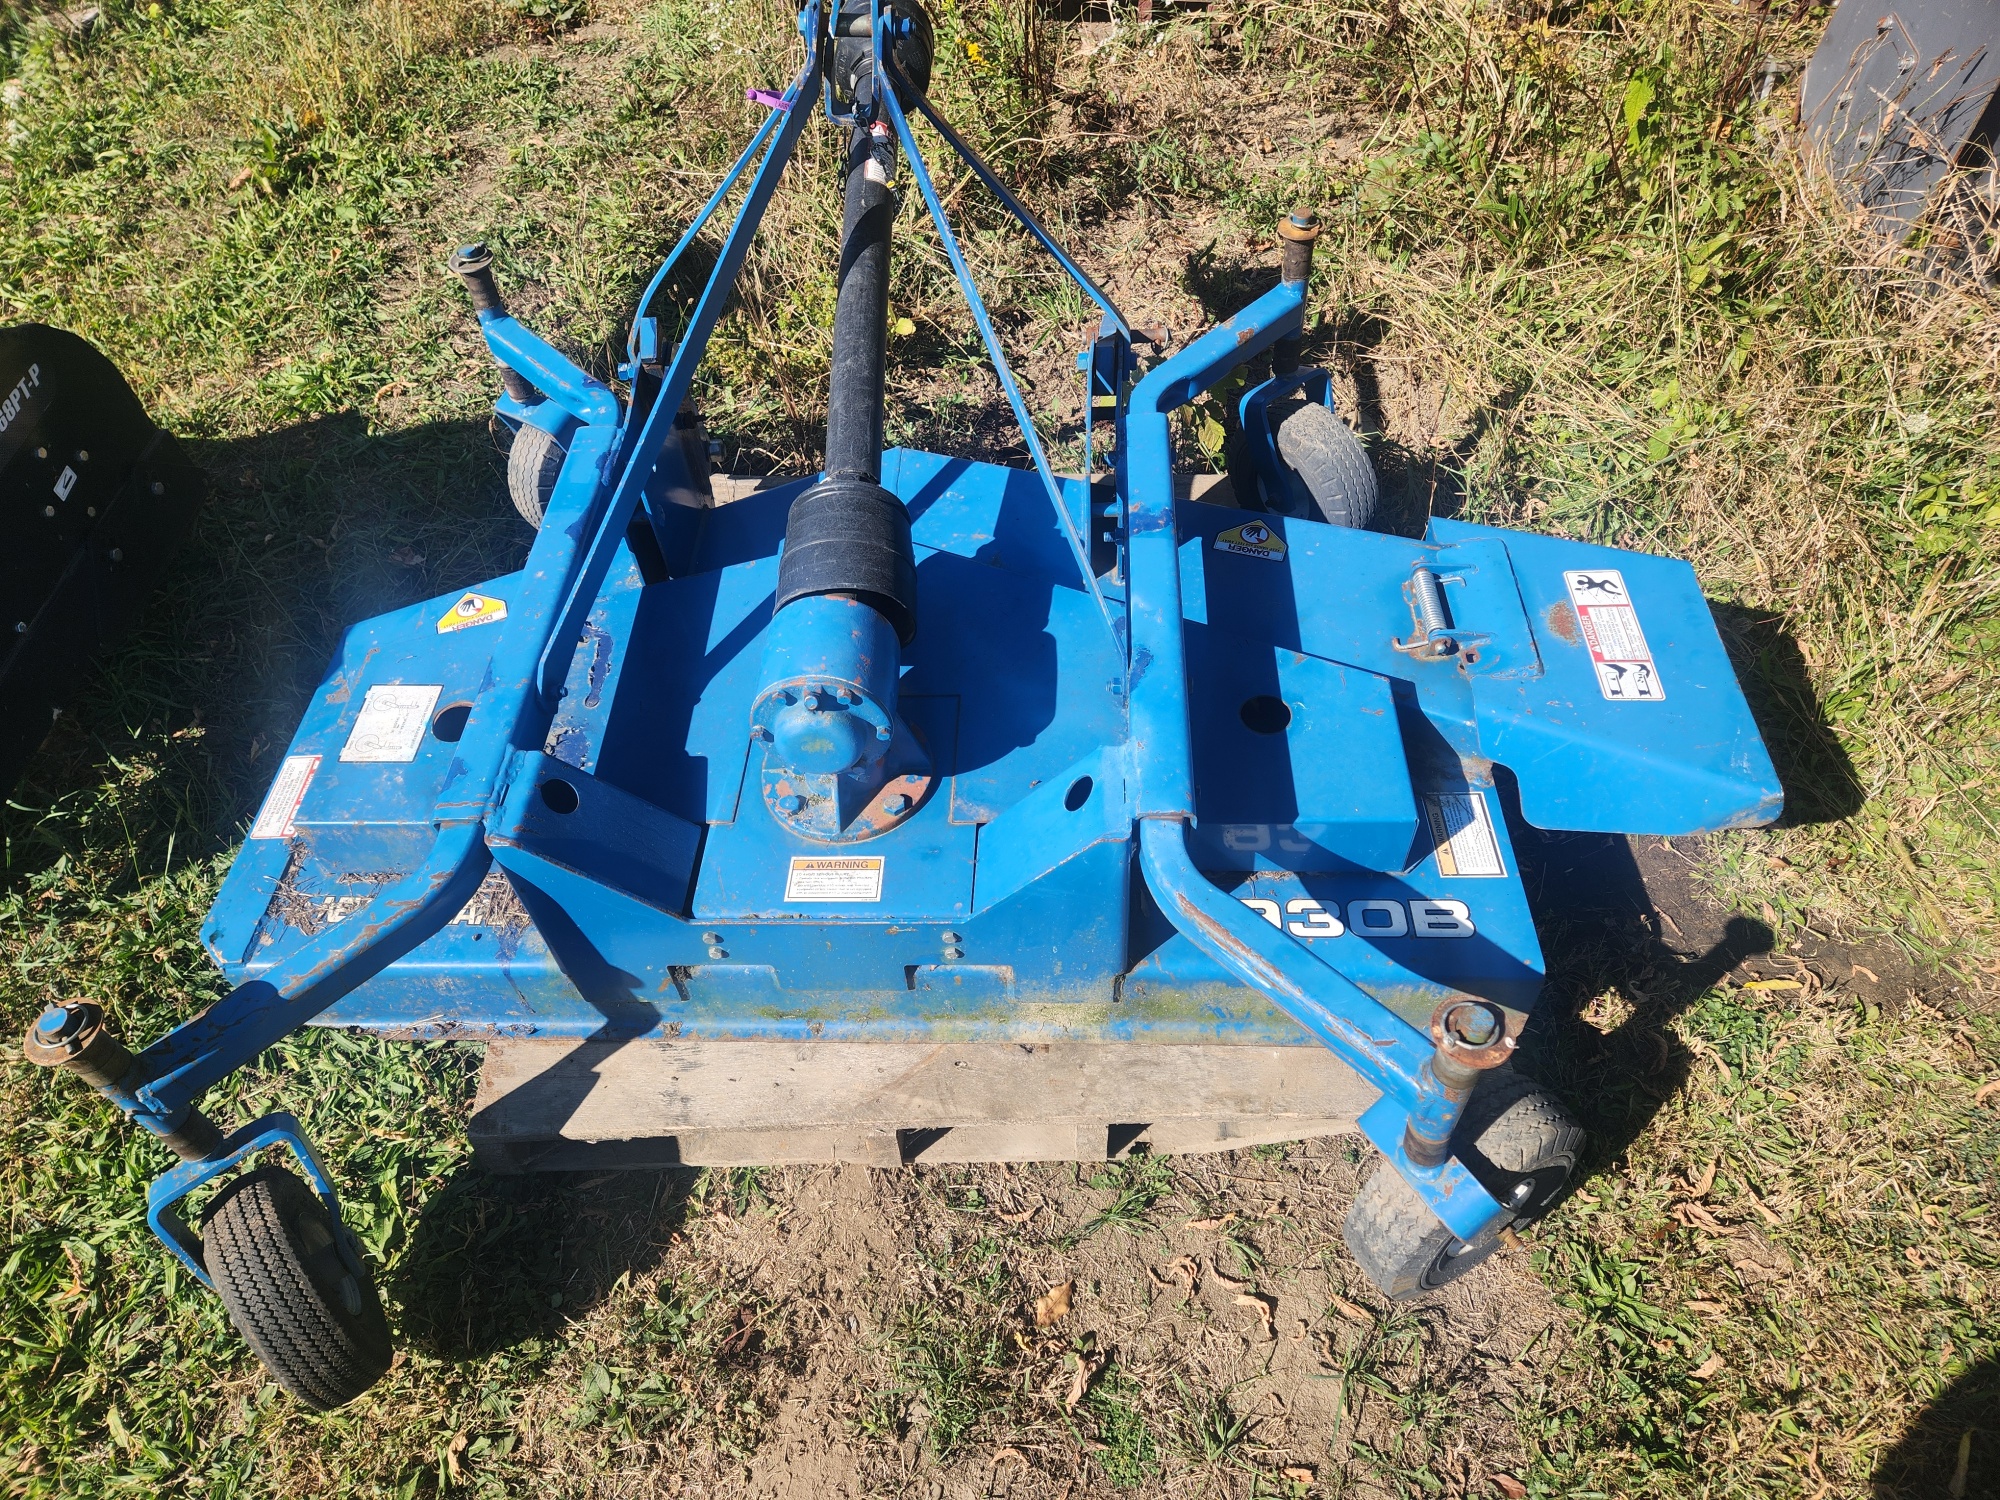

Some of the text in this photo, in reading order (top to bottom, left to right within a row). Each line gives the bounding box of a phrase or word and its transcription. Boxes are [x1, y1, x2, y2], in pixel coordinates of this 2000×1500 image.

[1228, 544, 1270, 557] DANGER
[452, 614, 493, 631] DANGER
[1581, 615, 1598, 645] DANGER
[1431, 812, 1446, 843] WARNING
[815, 860, 869, 869] WARNING
